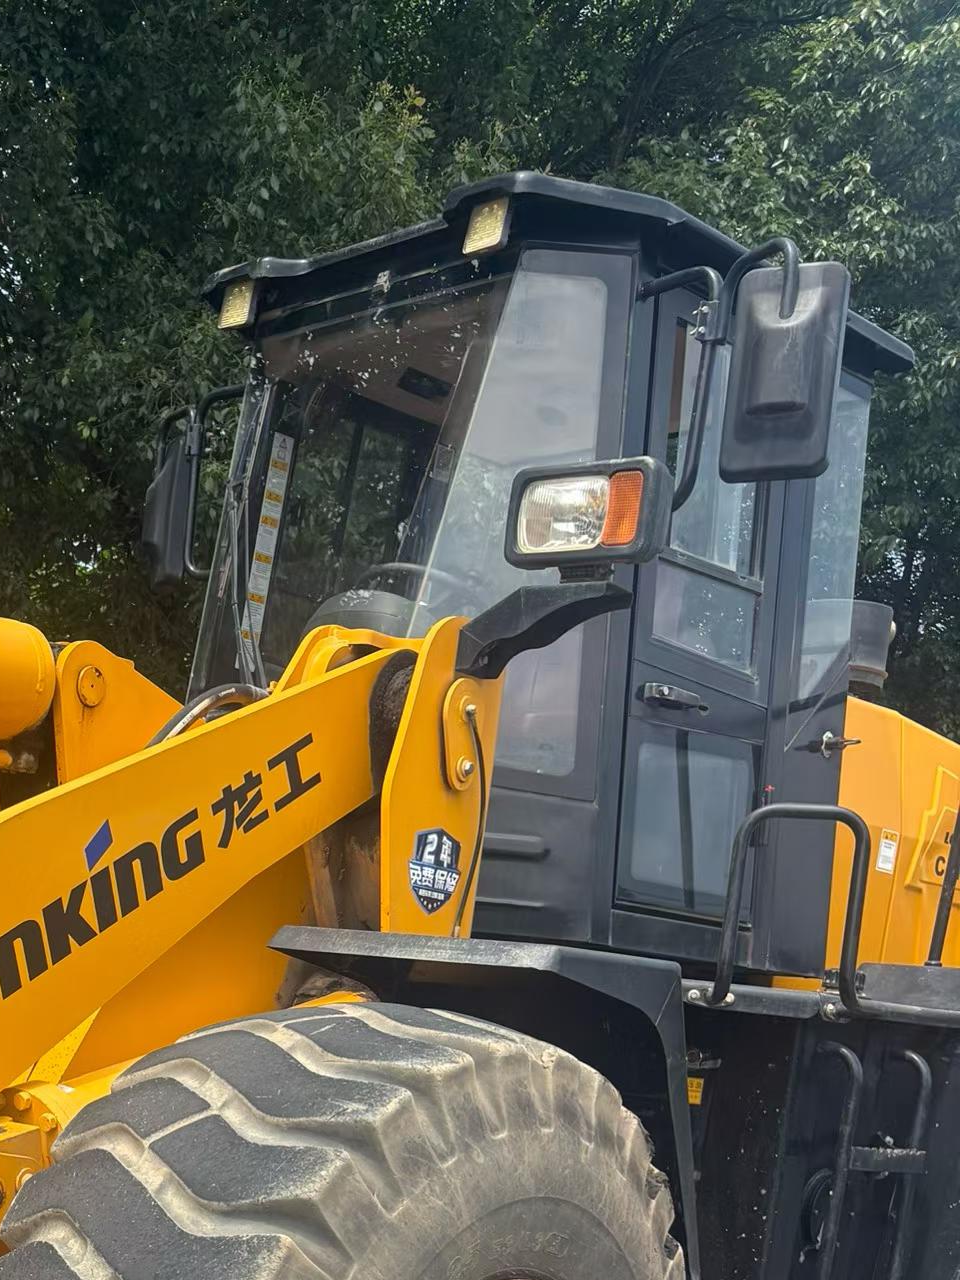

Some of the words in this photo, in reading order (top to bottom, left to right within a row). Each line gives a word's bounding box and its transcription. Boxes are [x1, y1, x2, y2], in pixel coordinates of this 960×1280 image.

[211, 732, 322, 849] 龙工
[422, 832, 452, 868] 2年
[409, 862, 460, 892] 免费保修
